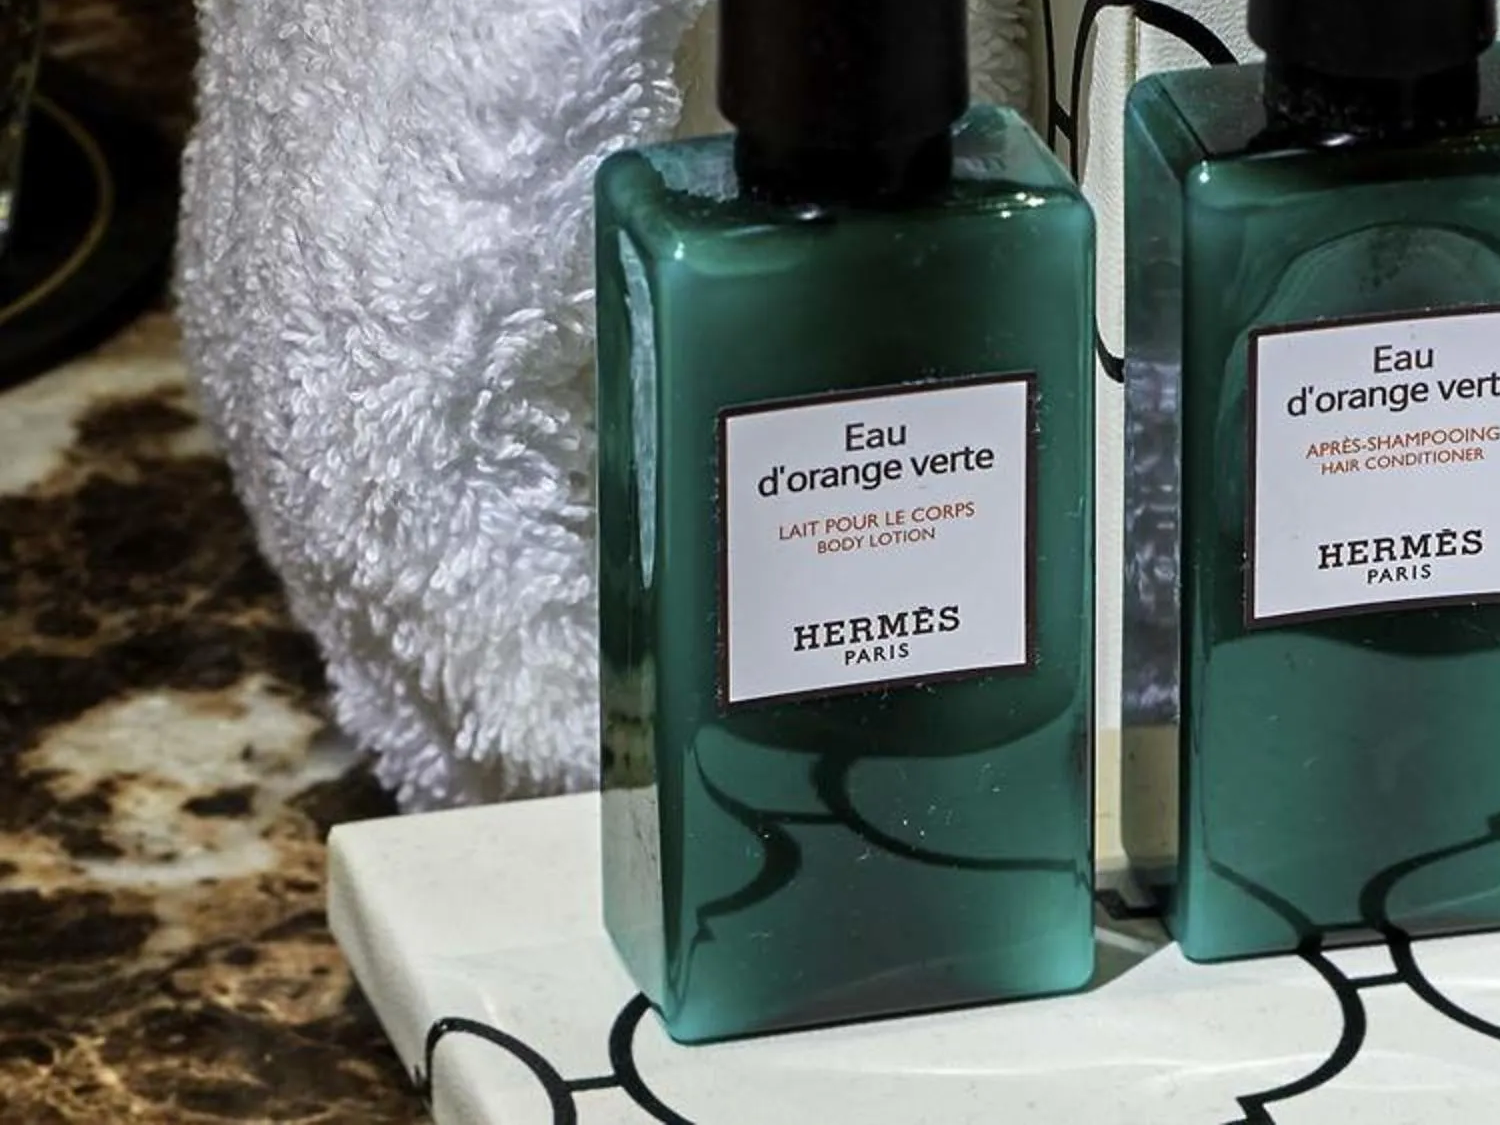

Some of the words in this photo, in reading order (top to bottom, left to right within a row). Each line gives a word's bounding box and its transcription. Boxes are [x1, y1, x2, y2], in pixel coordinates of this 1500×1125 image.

[1372, 344, 1434, 373] Eau
[1287, 382, 1428, 417] d'orange
[845, 422, 907, 452] Eau
[1306, 426, 1500, 459] APRÈS-SHAMPOOING
[757, 457, 902, 498] d'orange
[909, 445, 995, 477] verte
[1320, 458, 1360, 475] HAIR
[1365, 447, 1485, 470] CONDITIONER
[779, 520, 820, 540] LAIT
[825, 513, 878, 535] POUR
[885, 509, 905, 526] LE
[911, 501, 975, 524] CORPS
[817, 536, 864, 554] BODY
[869, 527, 936, 549] LOTION
[1318, 528, 1483, 570] HERMÈS
[1366, 563, 1432, 585] PARIS
[793, 606, 960, 652] HERMÈS
[844, 642, 909, 666] PARIS
